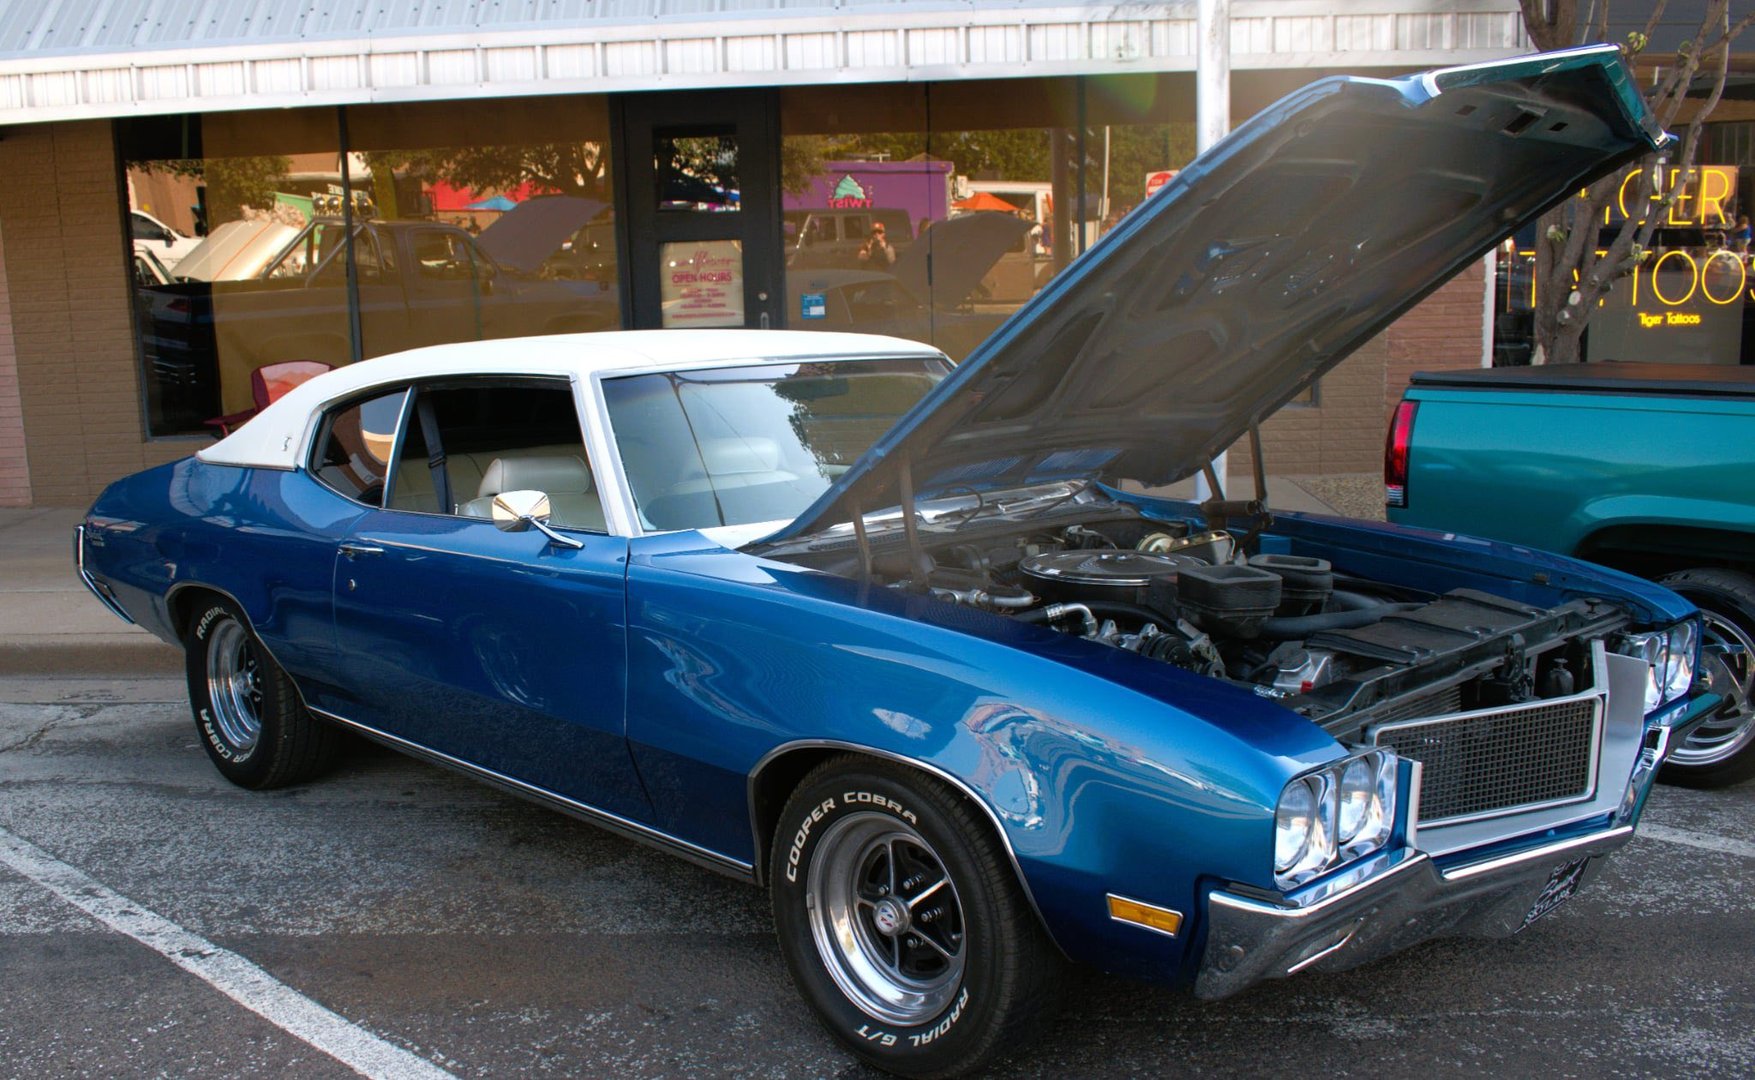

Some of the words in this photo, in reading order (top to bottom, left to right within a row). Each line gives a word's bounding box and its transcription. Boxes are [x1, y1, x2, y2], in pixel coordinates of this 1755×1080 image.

[672, 272, 697, 284] OPEN
[700, 270, 732, 282] HOURS
[1638, 312, 1663, 327] Tiger
[1666, 312, 1700, 324] Tattoos
[196, 606, 228, 640] RADIAL
[200, 708, 232, 760] COBRA
[786, 797, 836, 883] COOPER
[843, 791, 917, 825] COBRA
[908, 985, 969, 1047] RADIAL
[854, 1024, 896, 1047] G/T
